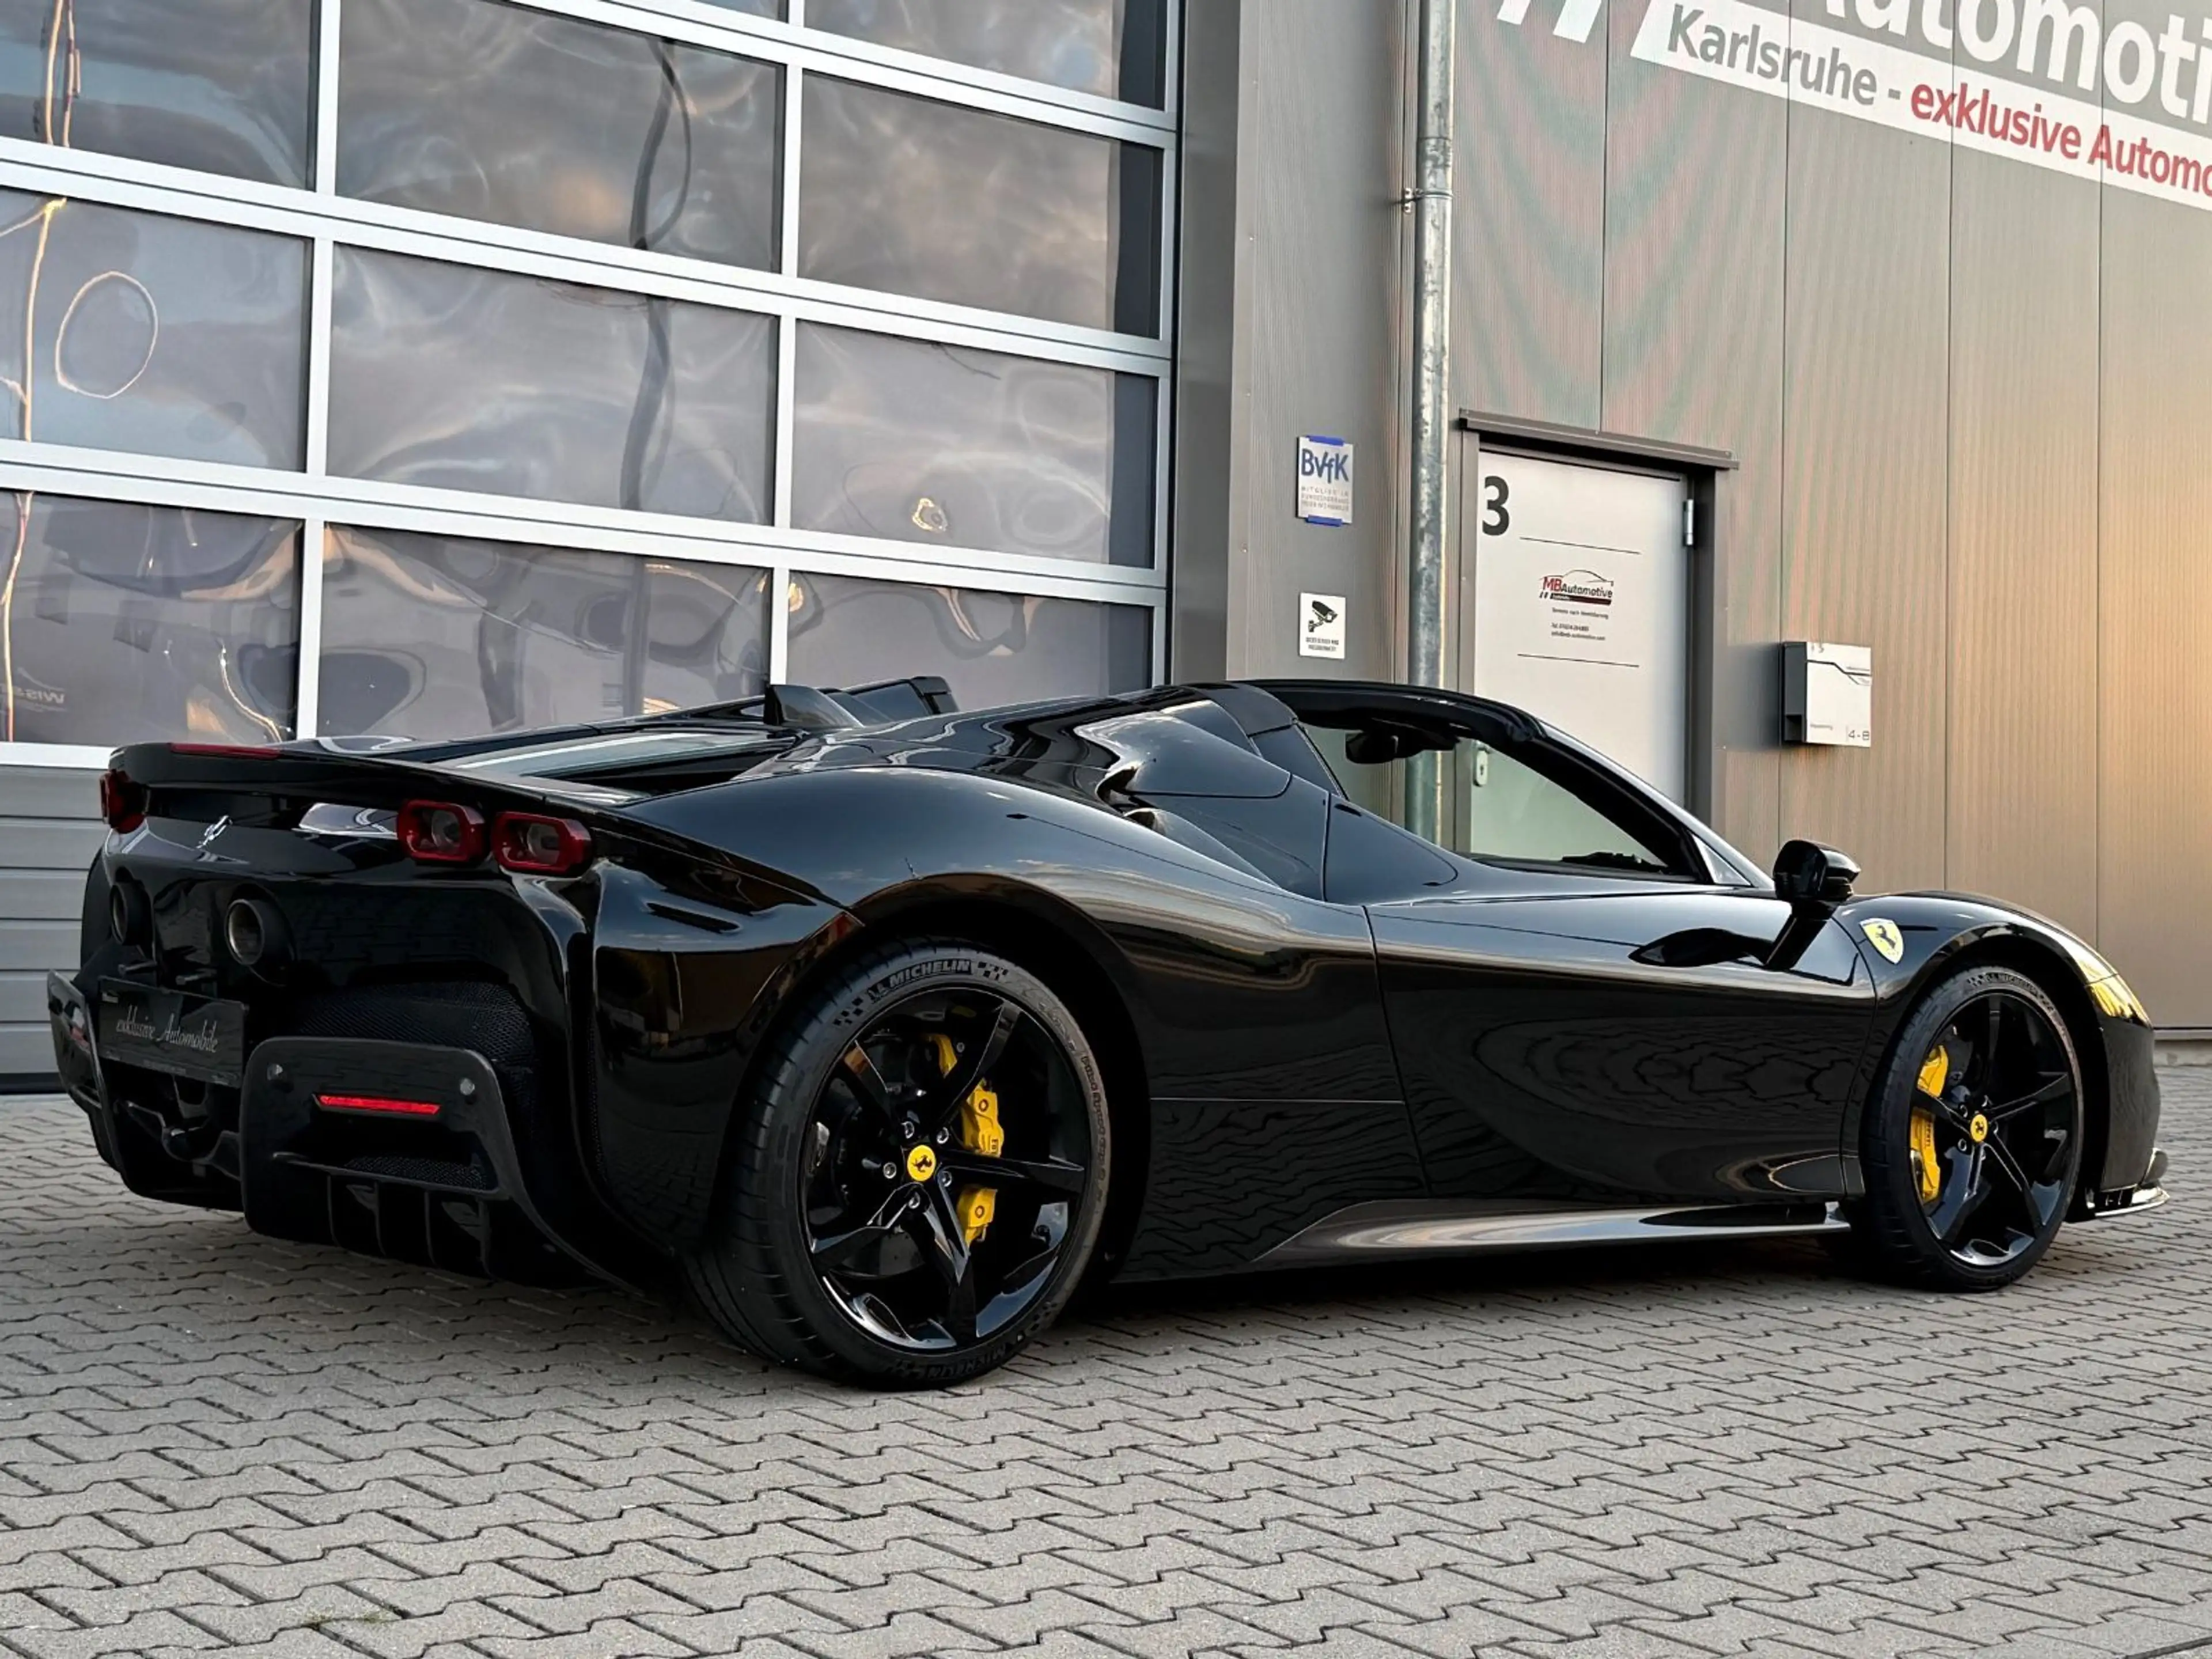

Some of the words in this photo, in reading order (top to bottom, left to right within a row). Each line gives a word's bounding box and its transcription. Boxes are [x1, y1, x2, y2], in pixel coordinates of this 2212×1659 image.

[1668, 4, 1877, 105] Karlsruhe
[1911, 82, 2081, 160] exklusive
[1482, 476, 1509, 535] 3
[890, 960, 969, 987] MICHELIN
[156, 1013, 218, 1054] Automobile
